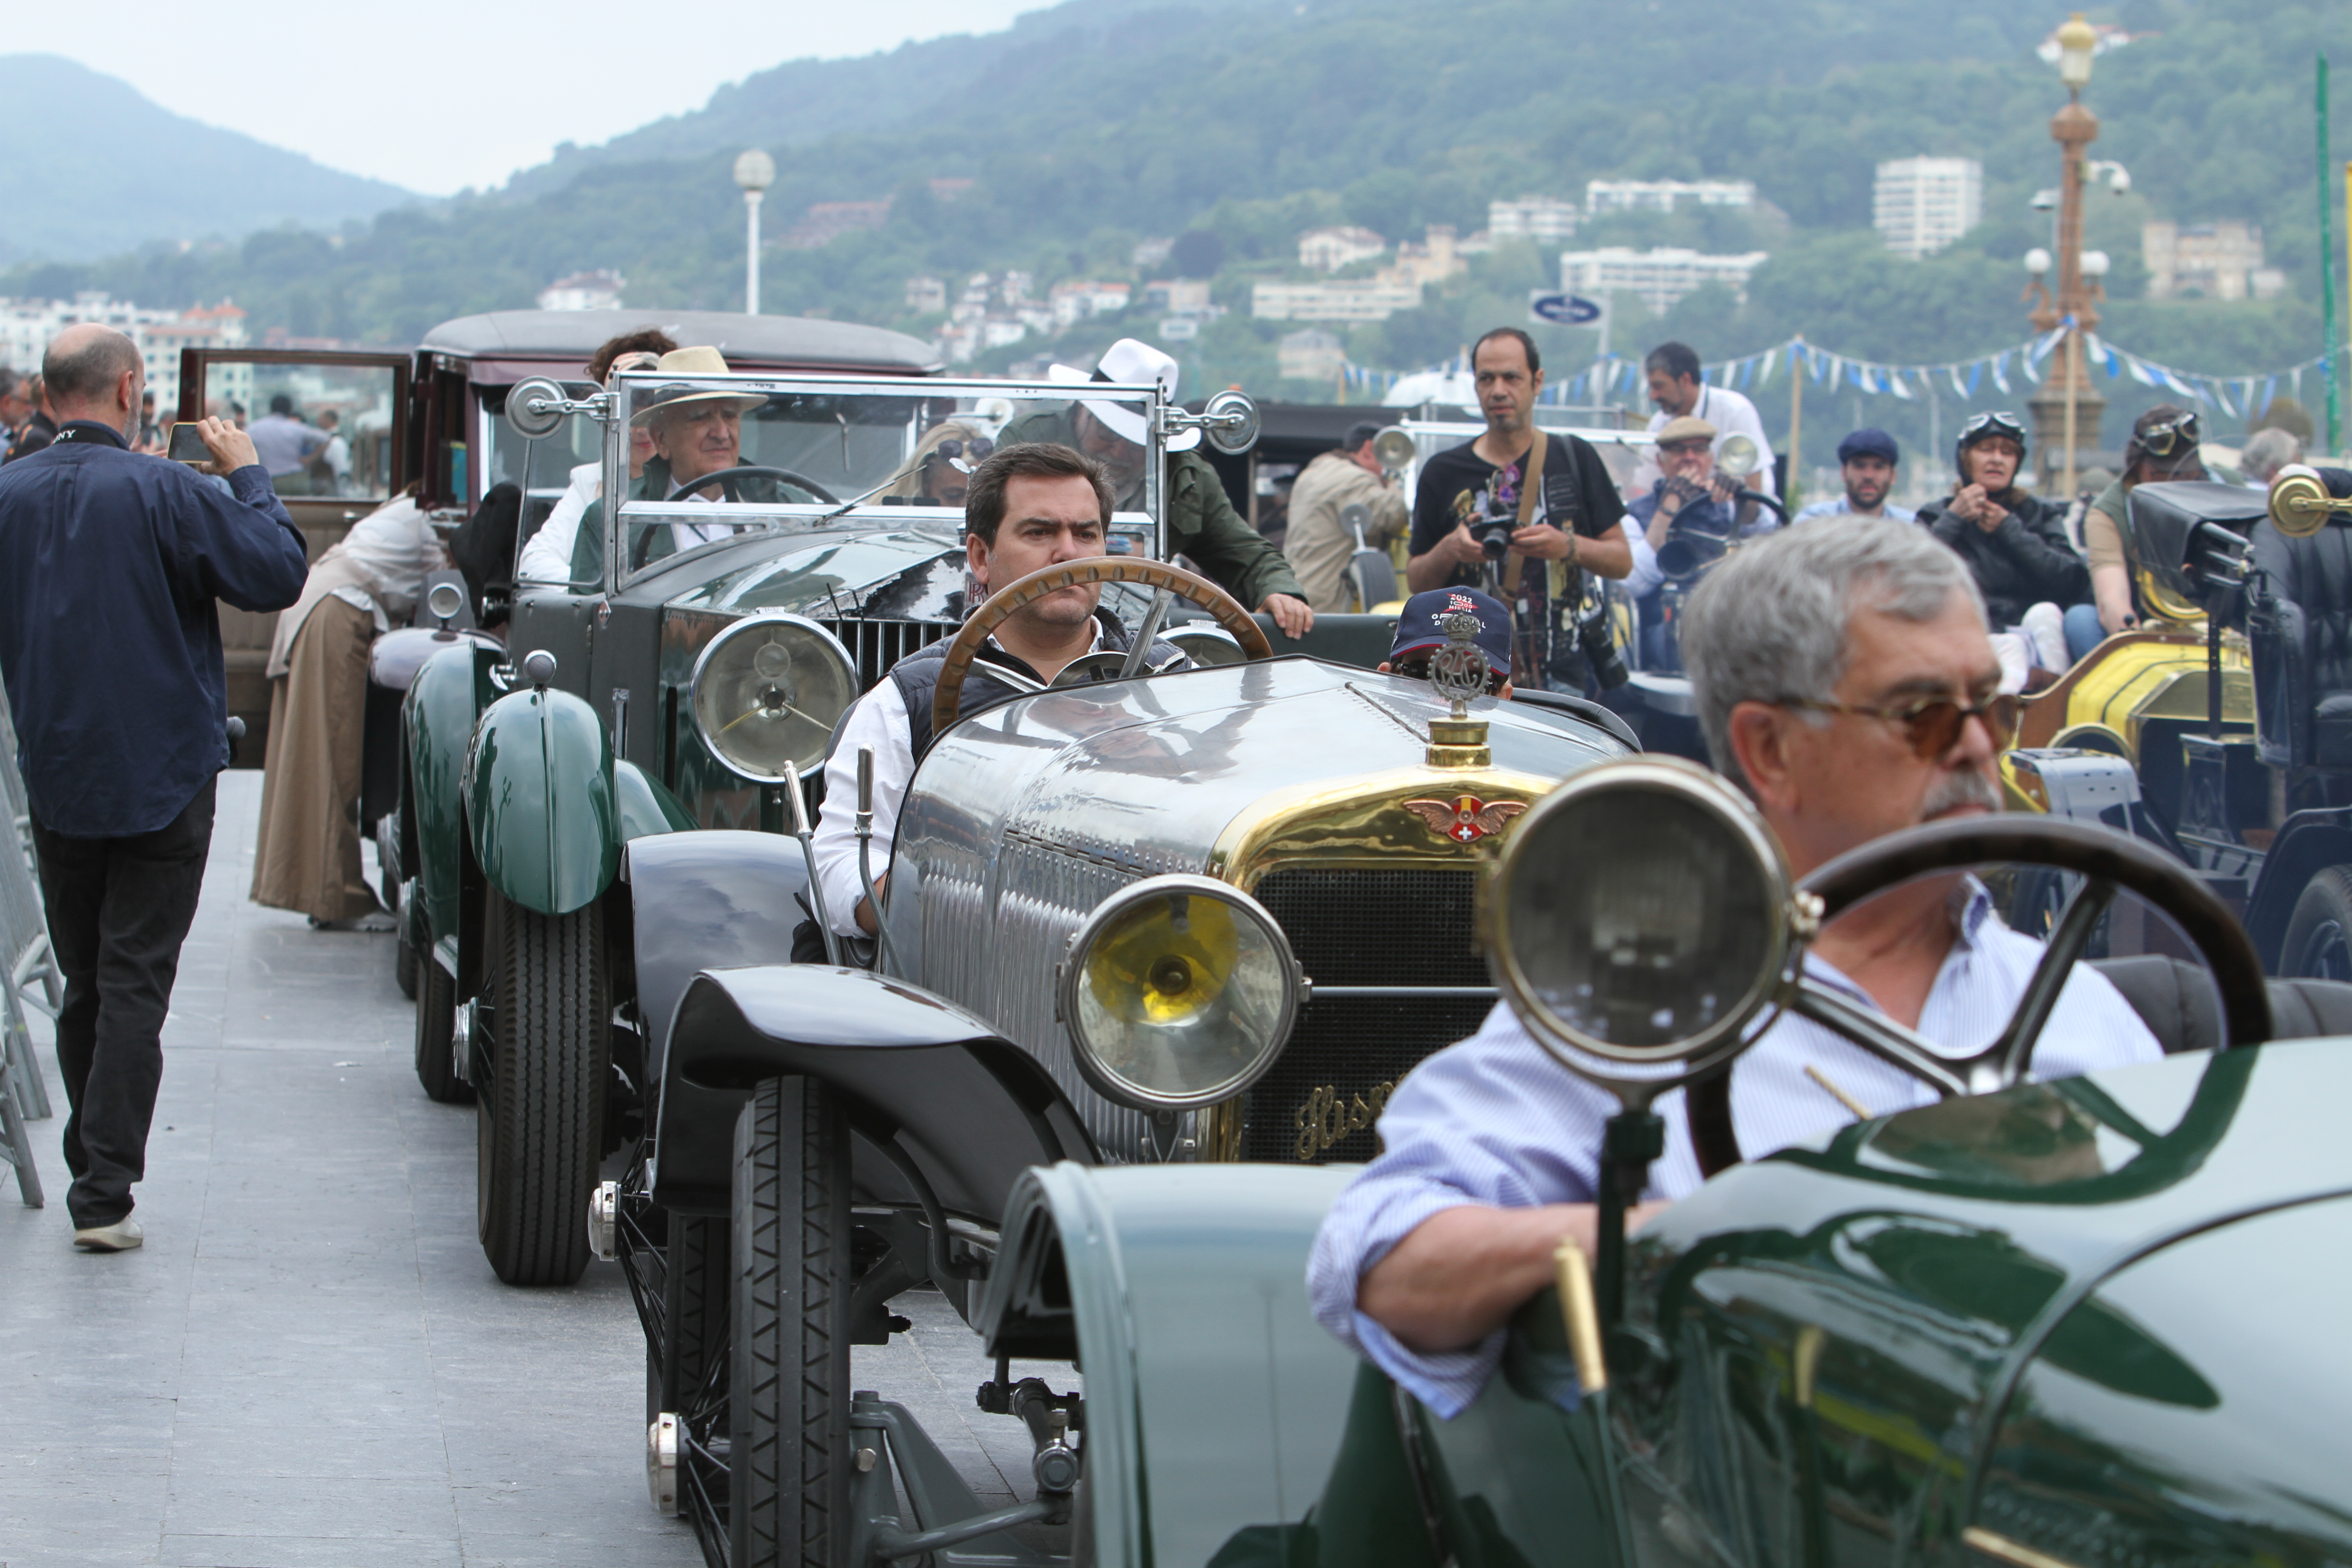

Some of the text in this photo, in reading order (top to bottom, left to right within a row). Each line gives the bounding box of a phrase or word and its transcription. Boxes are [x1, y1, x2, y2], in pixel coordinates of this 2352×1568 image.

[1450, 593, 1472, 604] 2022
[1449, 605, 1472, 613] MIGLIA
[1450, 600, 1473, 609] 1000
